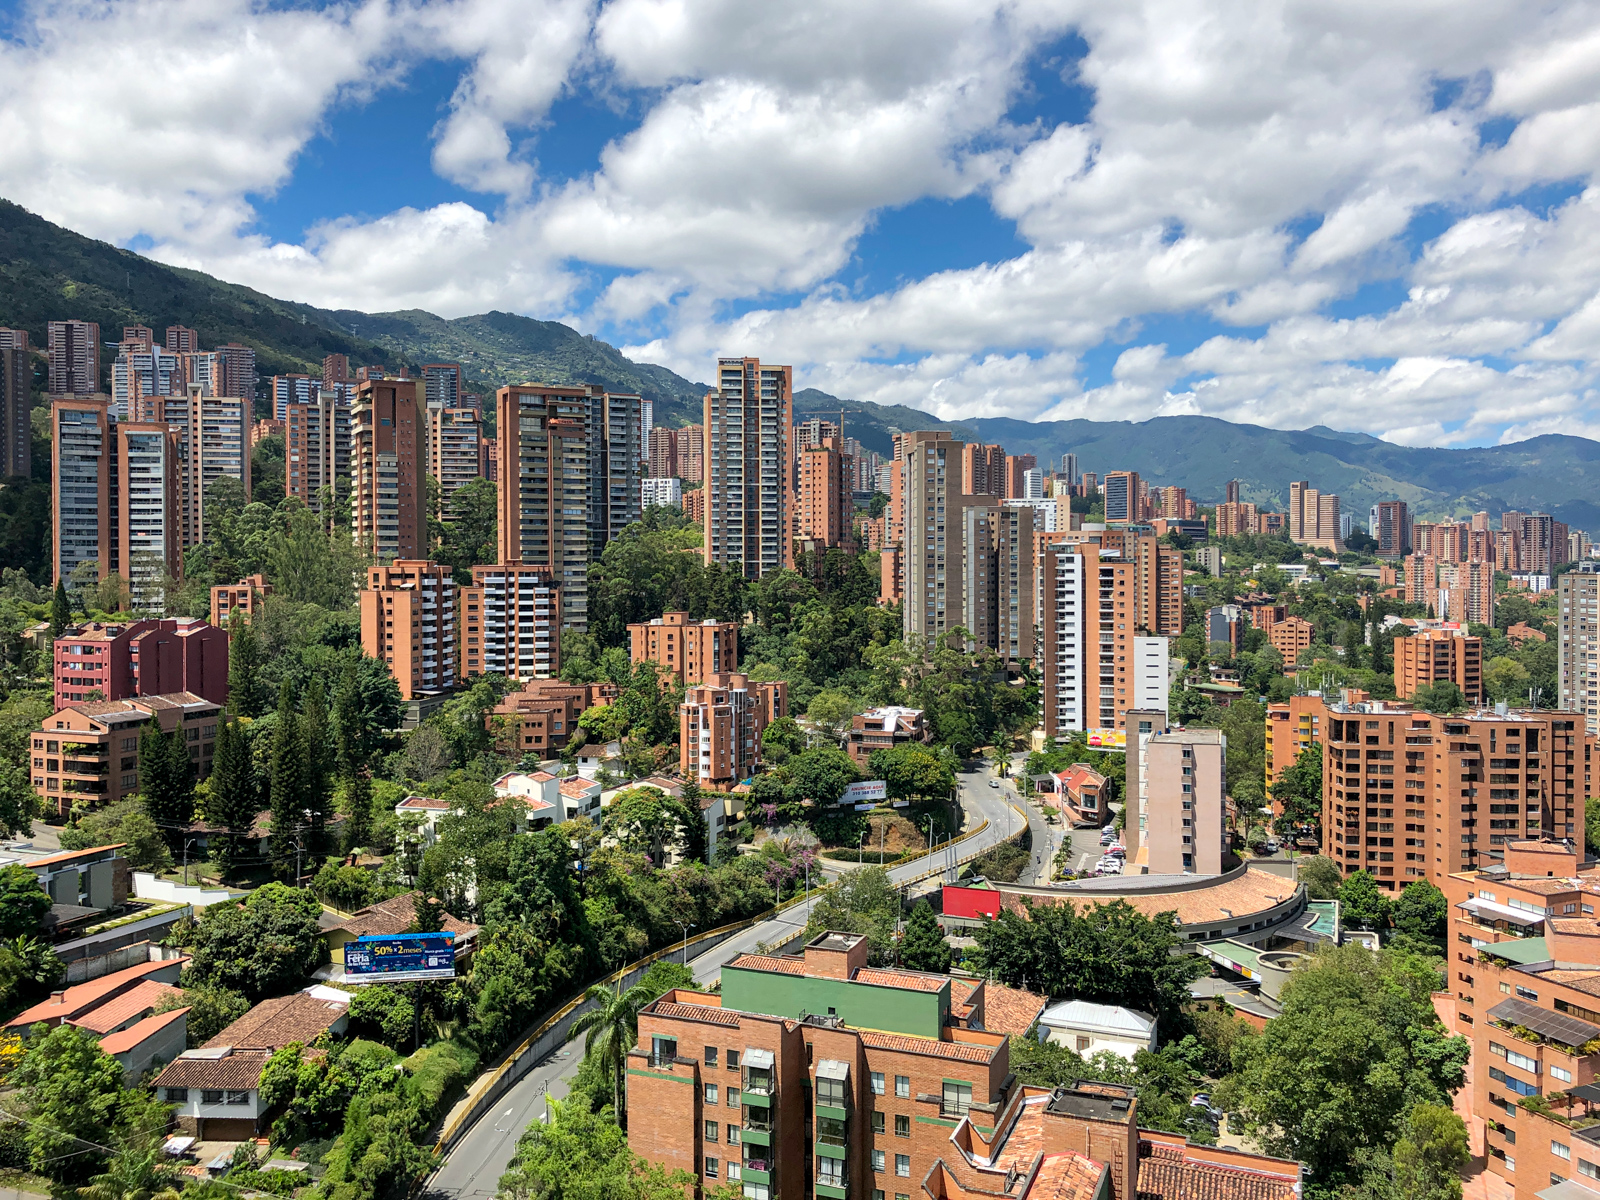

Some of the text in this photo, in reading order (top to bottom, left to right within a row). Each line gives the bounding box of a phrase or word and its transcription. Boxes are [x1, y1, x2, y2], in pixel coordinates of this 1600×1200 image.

[374, 945, 393, 956] 50%
[397, 945, 404, 954] 2
[347, 954, 370, 962] Feria
